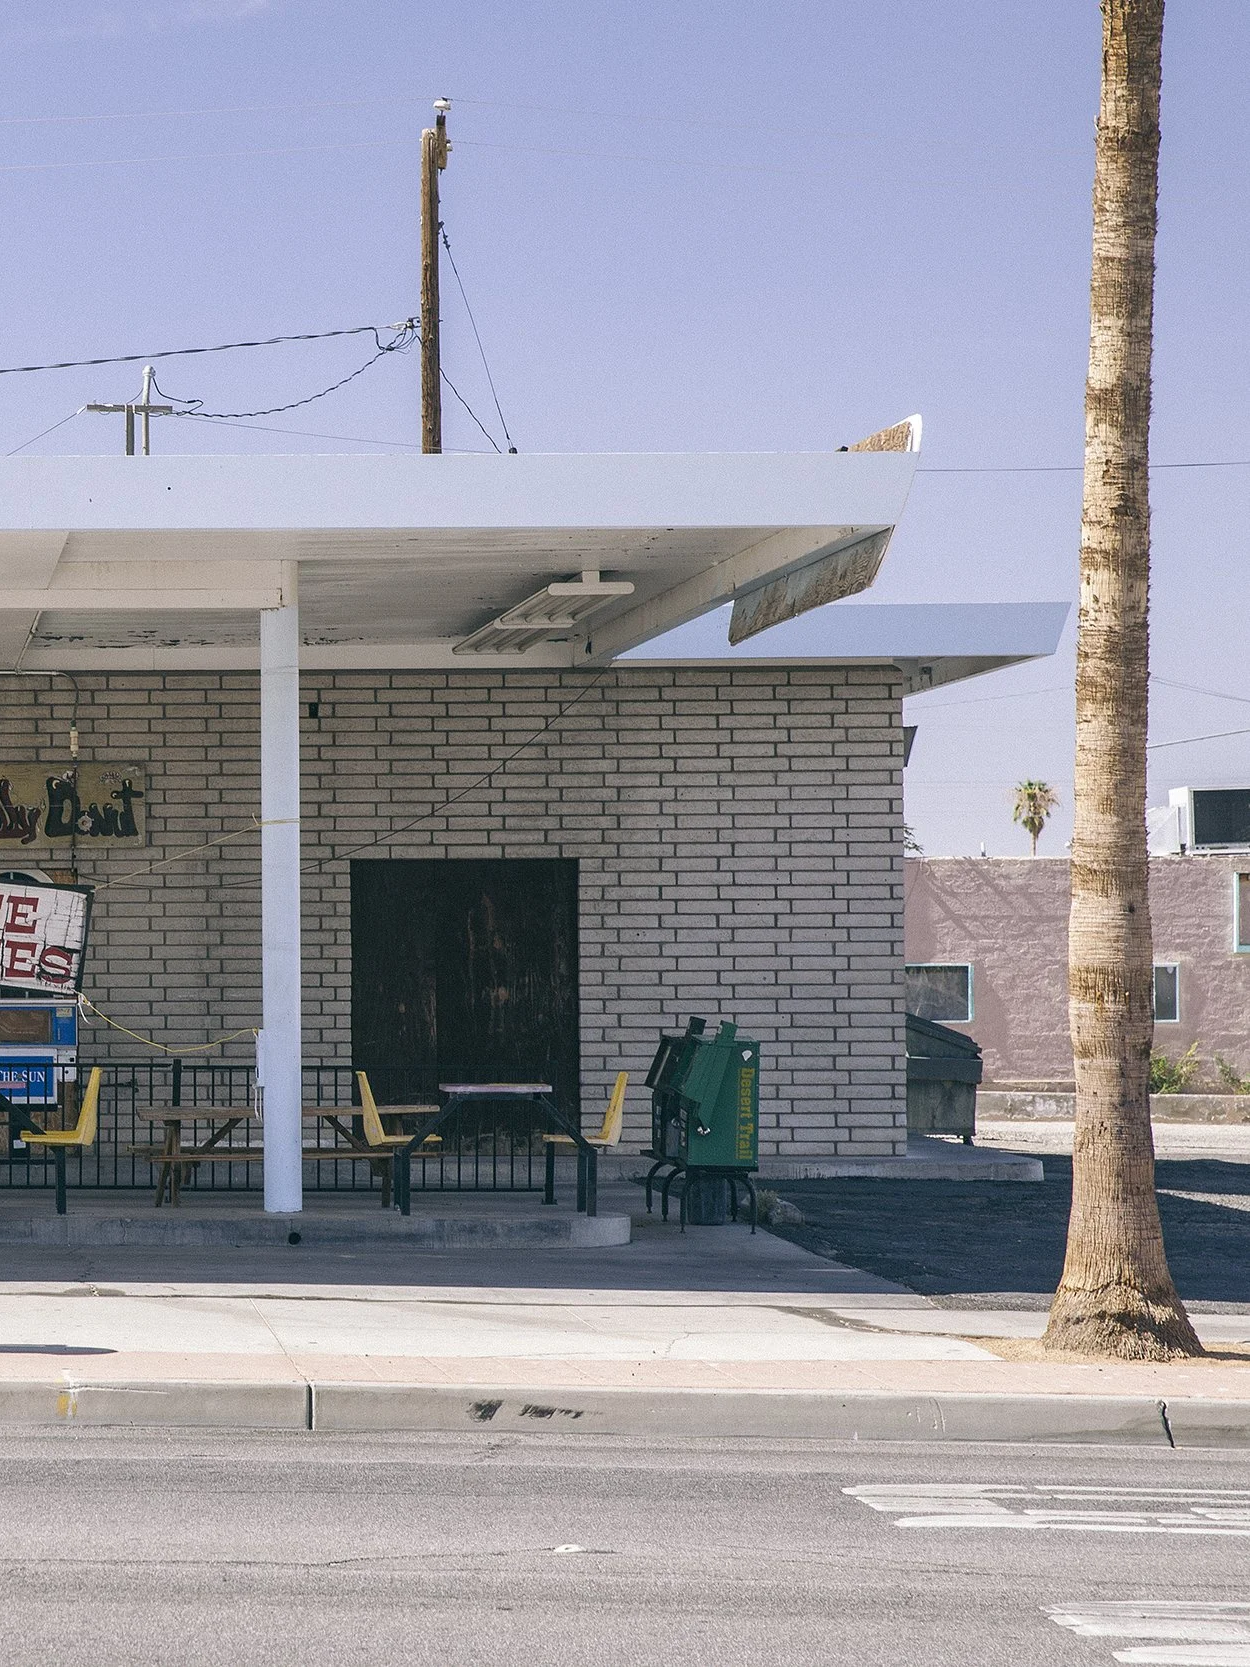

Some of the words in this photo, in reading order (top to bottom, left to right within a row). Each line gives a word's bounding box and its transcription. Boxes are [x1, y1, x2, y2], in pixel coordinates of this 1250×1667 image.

[21, 1070, 45, 1083] SUN
[740, 1067, 755, 1118] Desert
[738, 1123, 753, 1159] Trail
